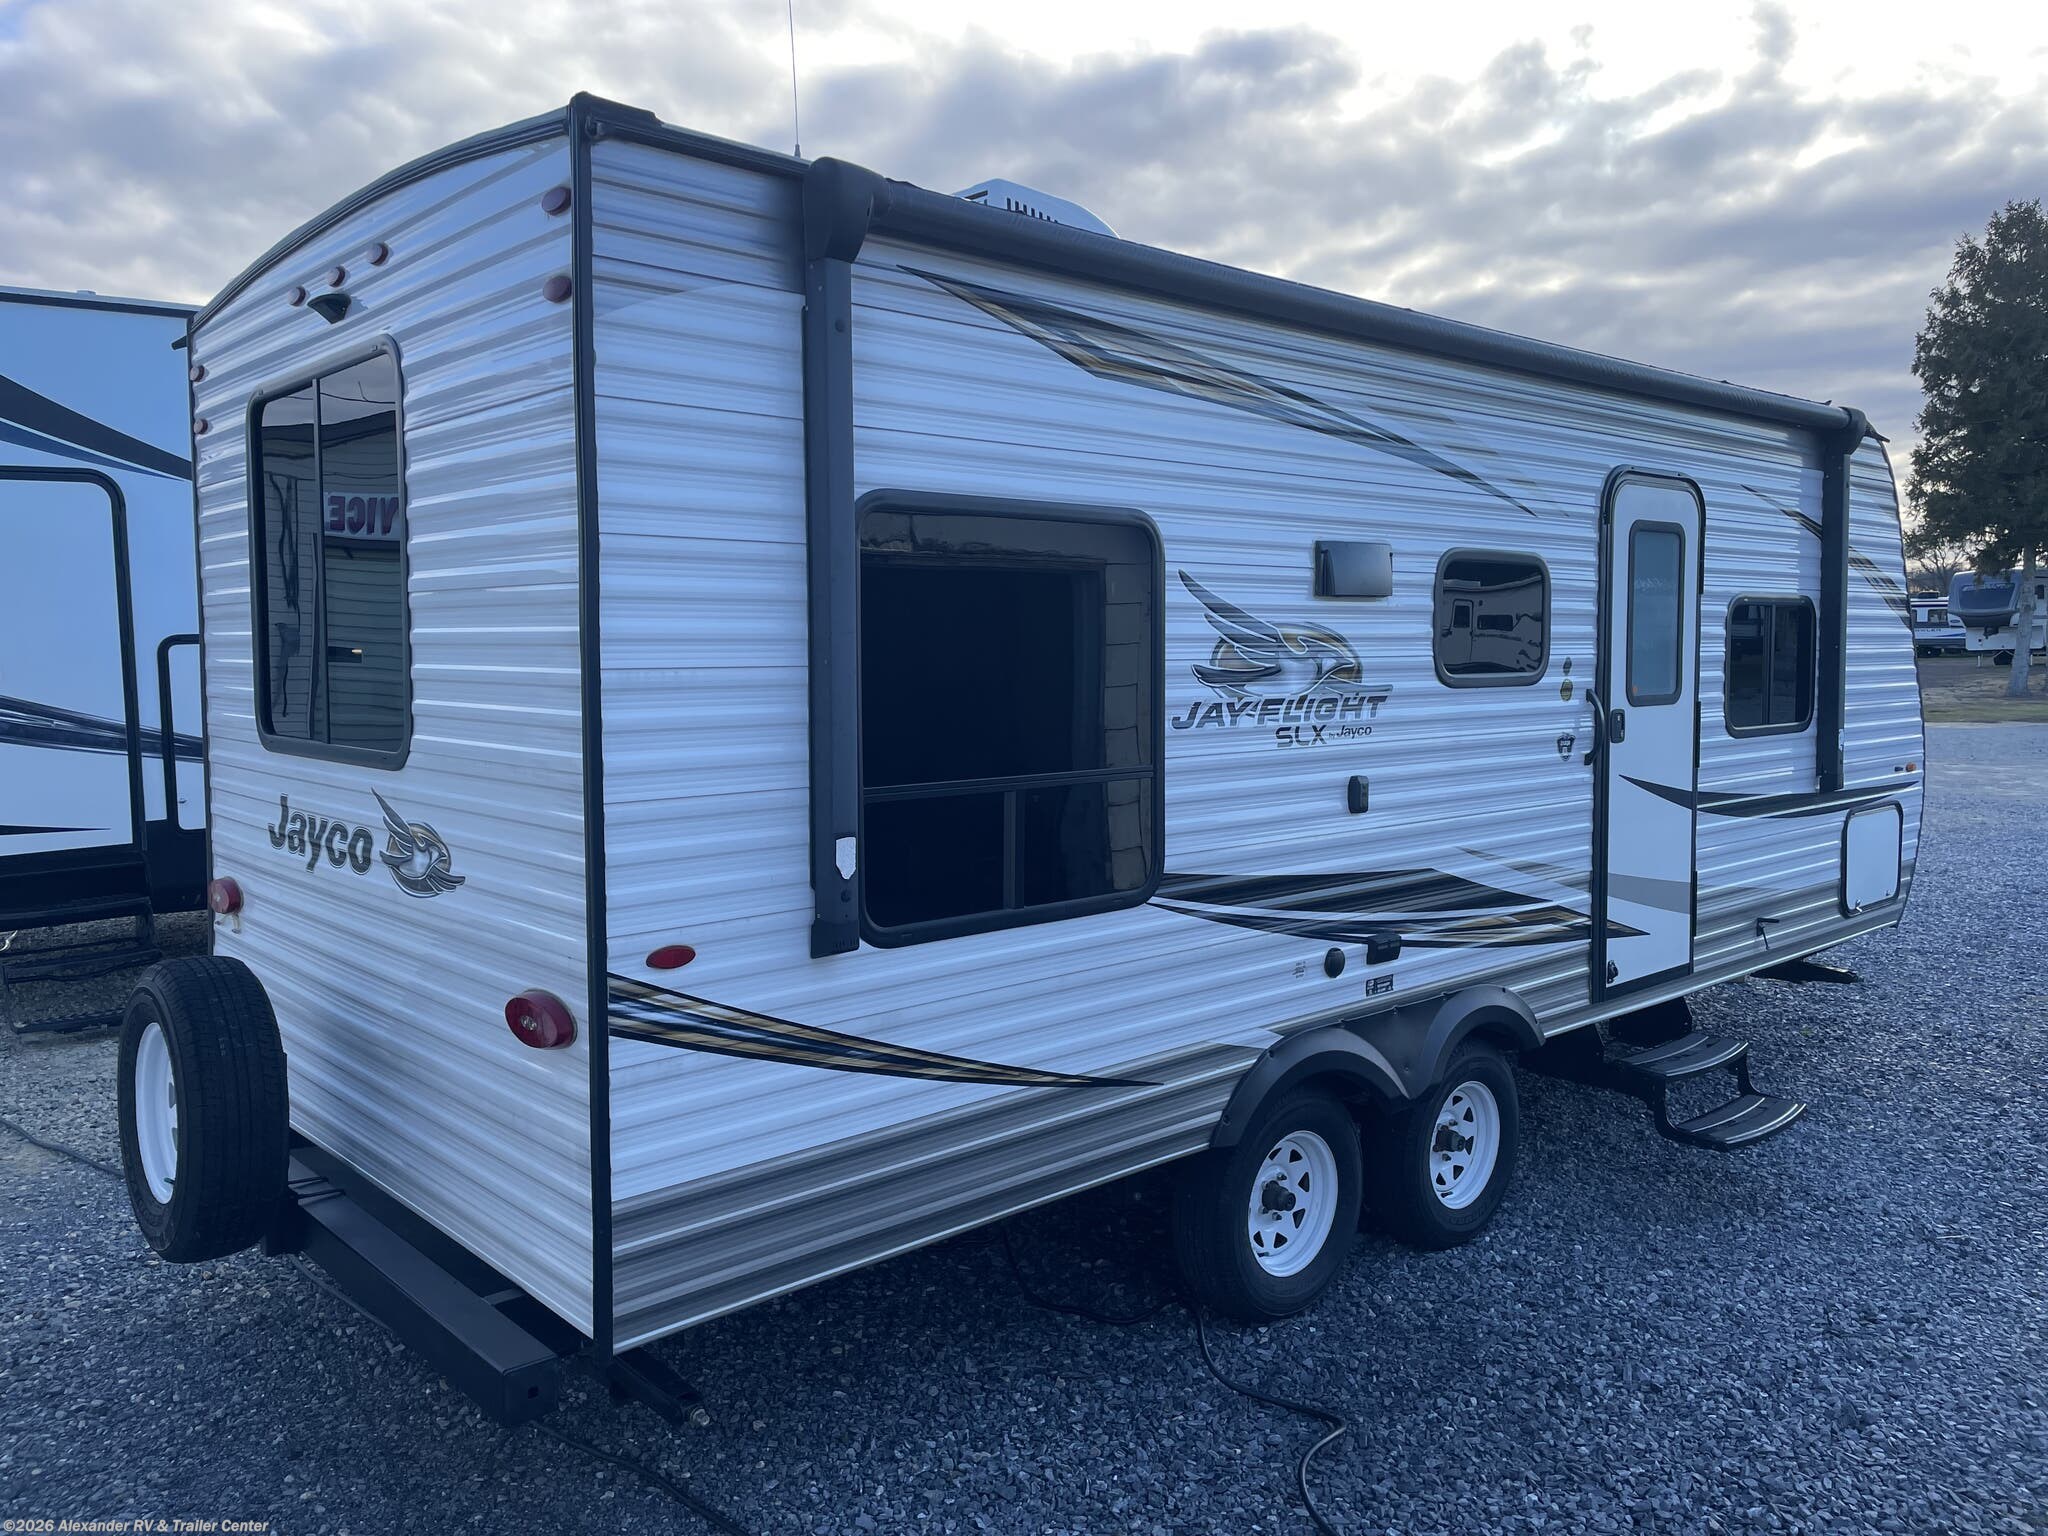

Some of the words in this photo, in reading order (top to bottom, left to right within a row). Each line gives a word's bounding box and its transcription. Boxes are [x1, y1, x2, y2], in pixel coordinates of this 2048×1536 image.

[1275, 725, 1327, 748] SLX
[1337, 725, 1372, 739] Jayco
[268, 793, 373, 875] Jayco
